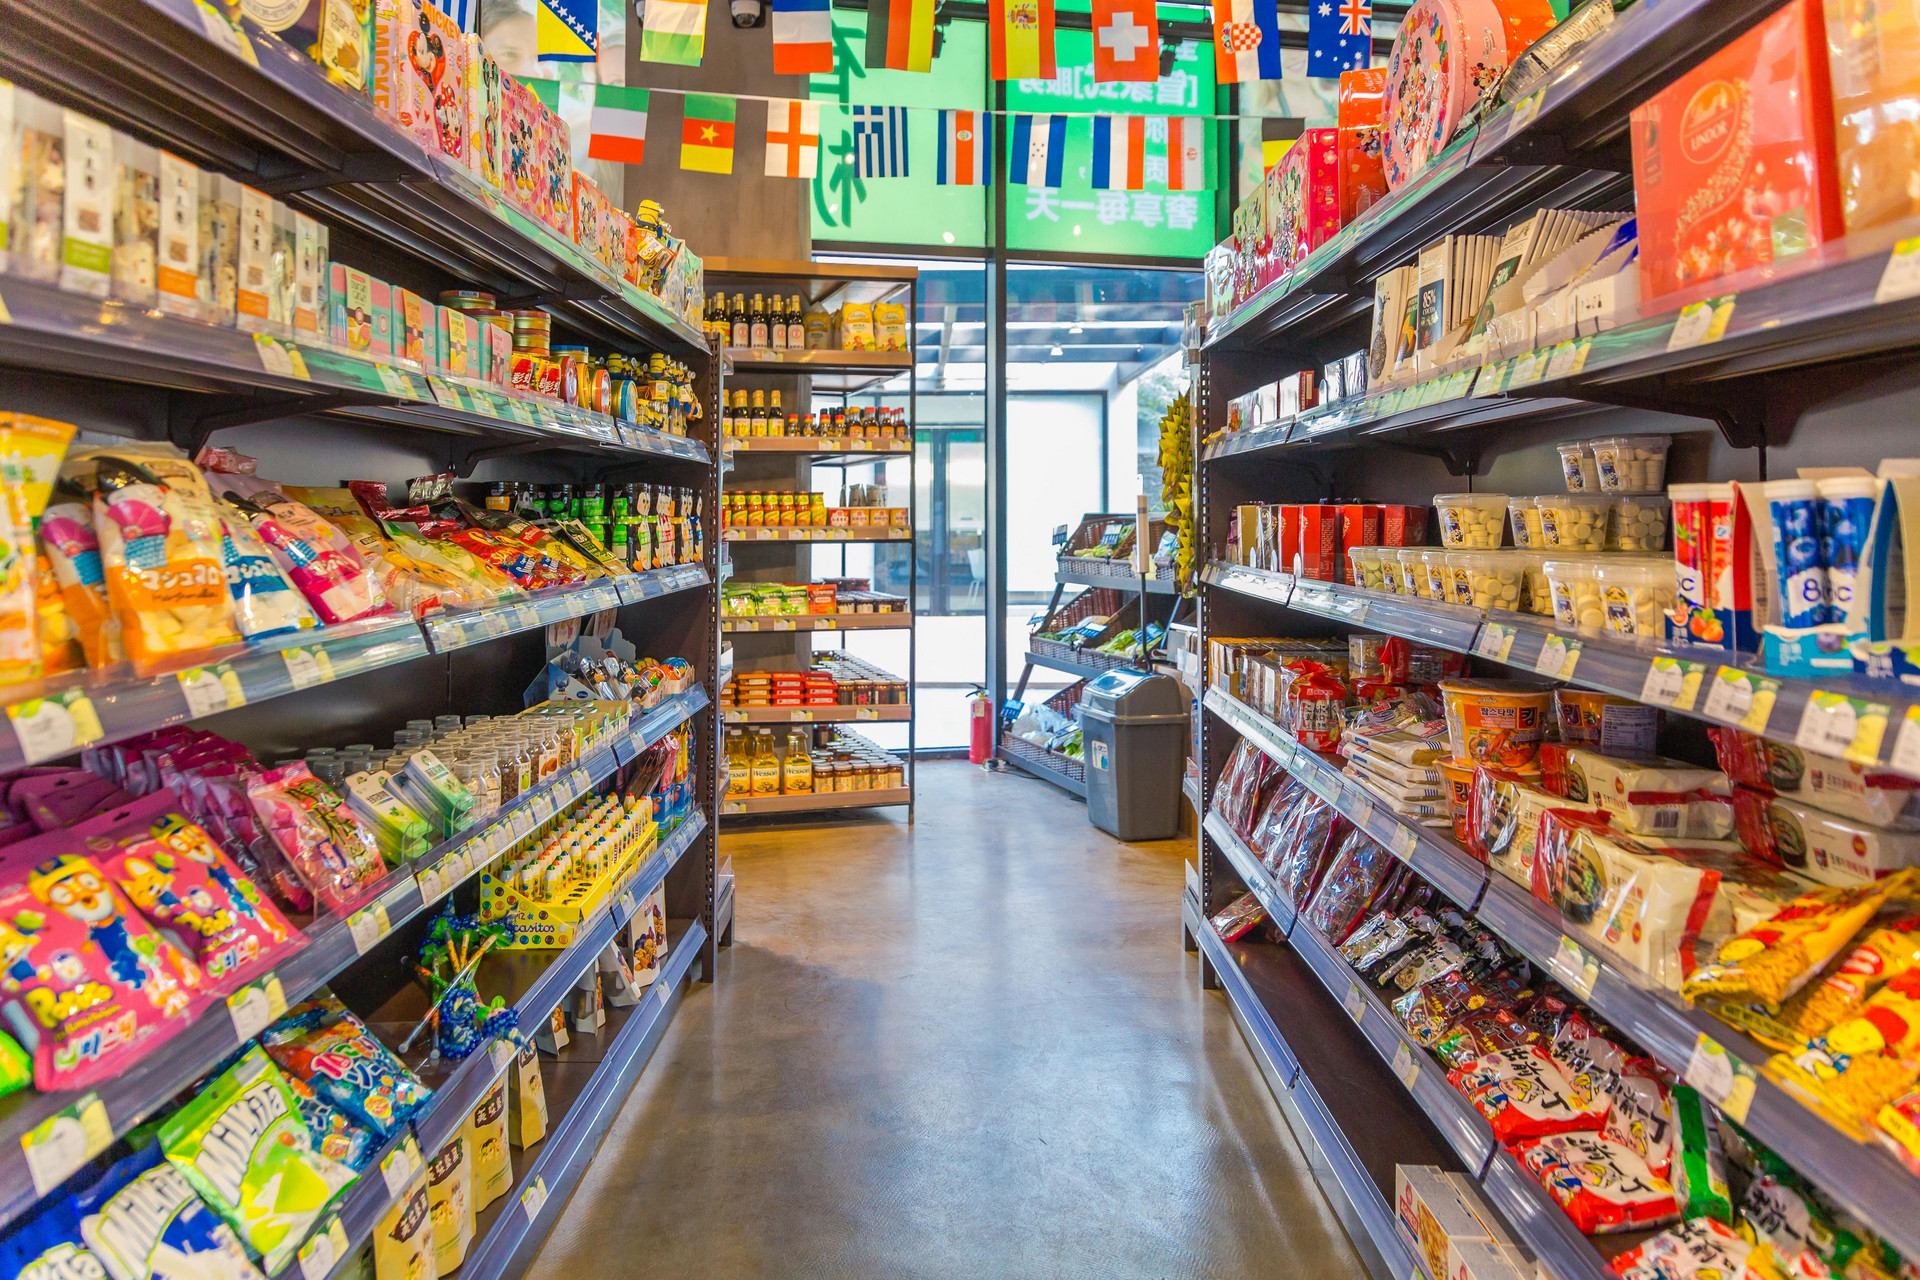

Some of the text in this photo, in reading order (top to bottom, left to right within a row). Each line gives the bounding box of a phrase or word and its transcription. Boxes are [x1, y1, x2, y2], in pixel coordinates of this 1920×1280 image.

[421, 0, 462, 42] MICKEY
[374, 24, 390, 110] MICKE
[1422, 288, 1437, 309] 85%
[1422, 306, 1436, 315] COCOA
[1480, 706, 1515, 717] 랍스타맛
[1521, 707, 1536, 727] 킹
[751, 769, 778, 778] Wesson
[786, 766, 811, 775] Wesson
[513, 923, 555, 933] casitos
[1500, 1047, 1571, 1114] 出前一丁
